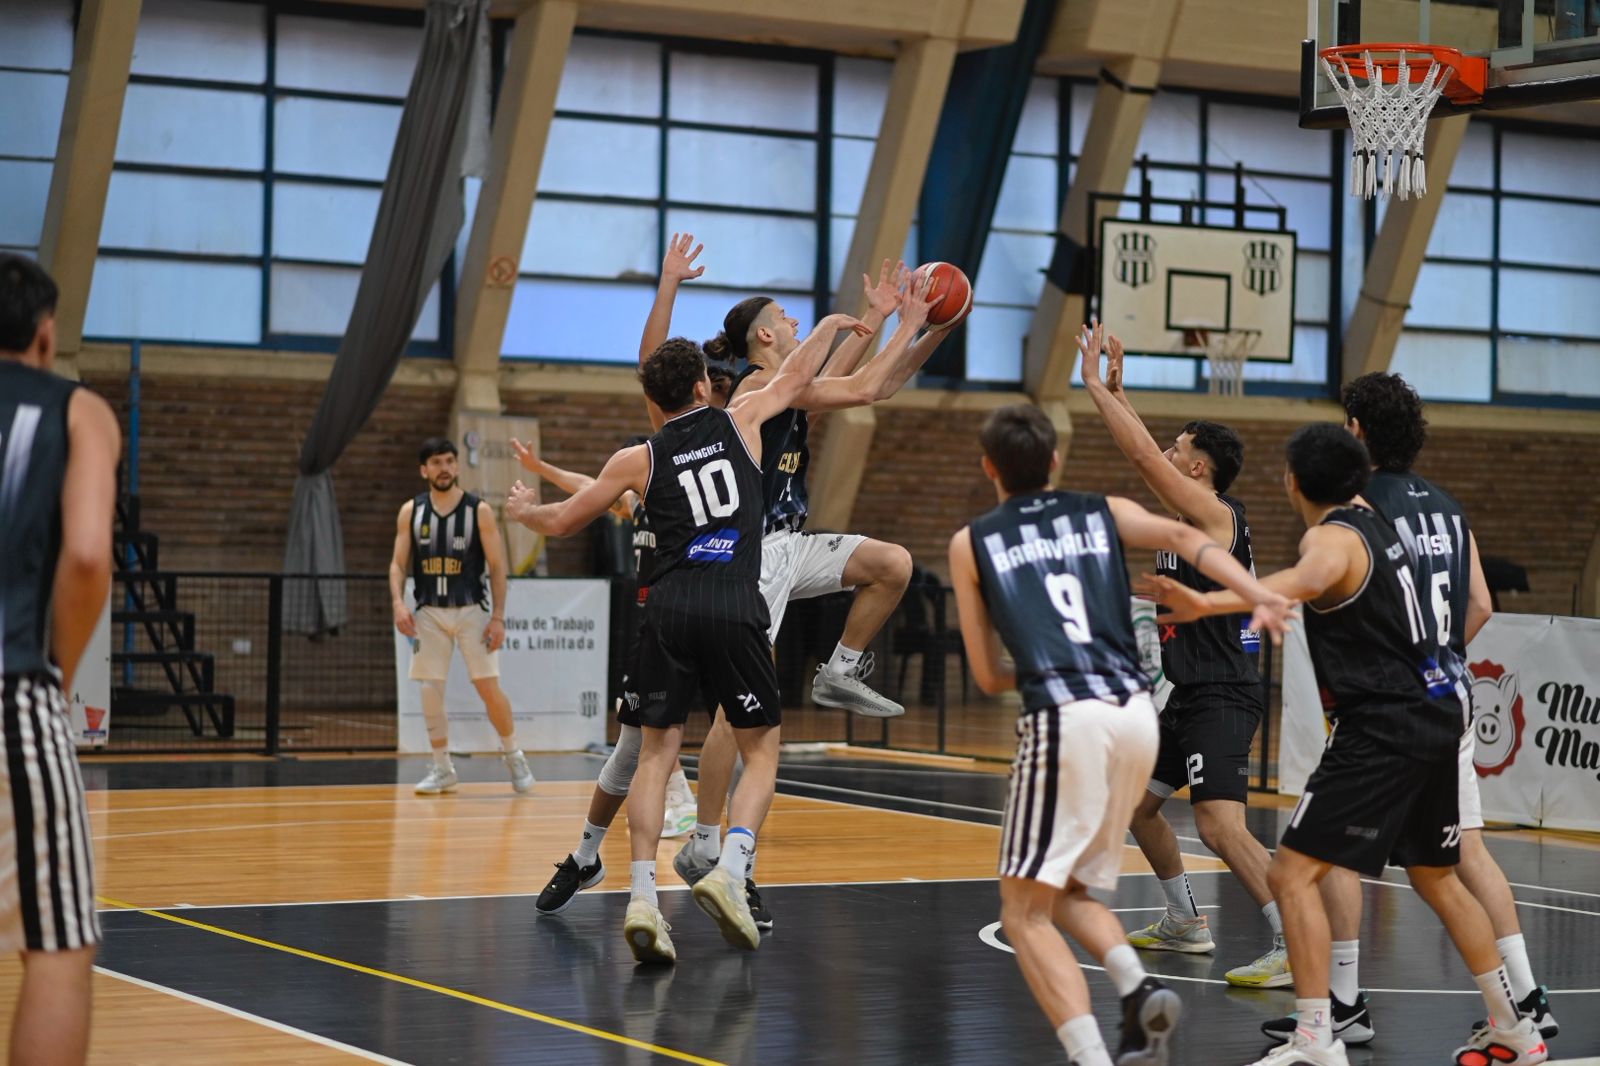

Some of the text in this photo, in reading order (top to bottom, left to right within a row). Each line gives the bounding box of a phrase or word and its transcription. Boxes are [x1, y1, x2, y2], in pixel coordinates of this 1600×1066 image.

[672, 442, 725, 465] DOMÍNGUEZ
[677, 458, 740, 527] 10
[992, 529, 1110, 573] BARAVALLE
[437, 576, 448, 596] 11
[1044, 572, 1093, 643] 9
[1431, 568, 1451, 646] 6
[528, 636, 595, 650] Limitada
[532, 617, 548, 631] de
[551, 616, 595, 633] Trabajo
[1534, 725, 1600, 782] Ma
